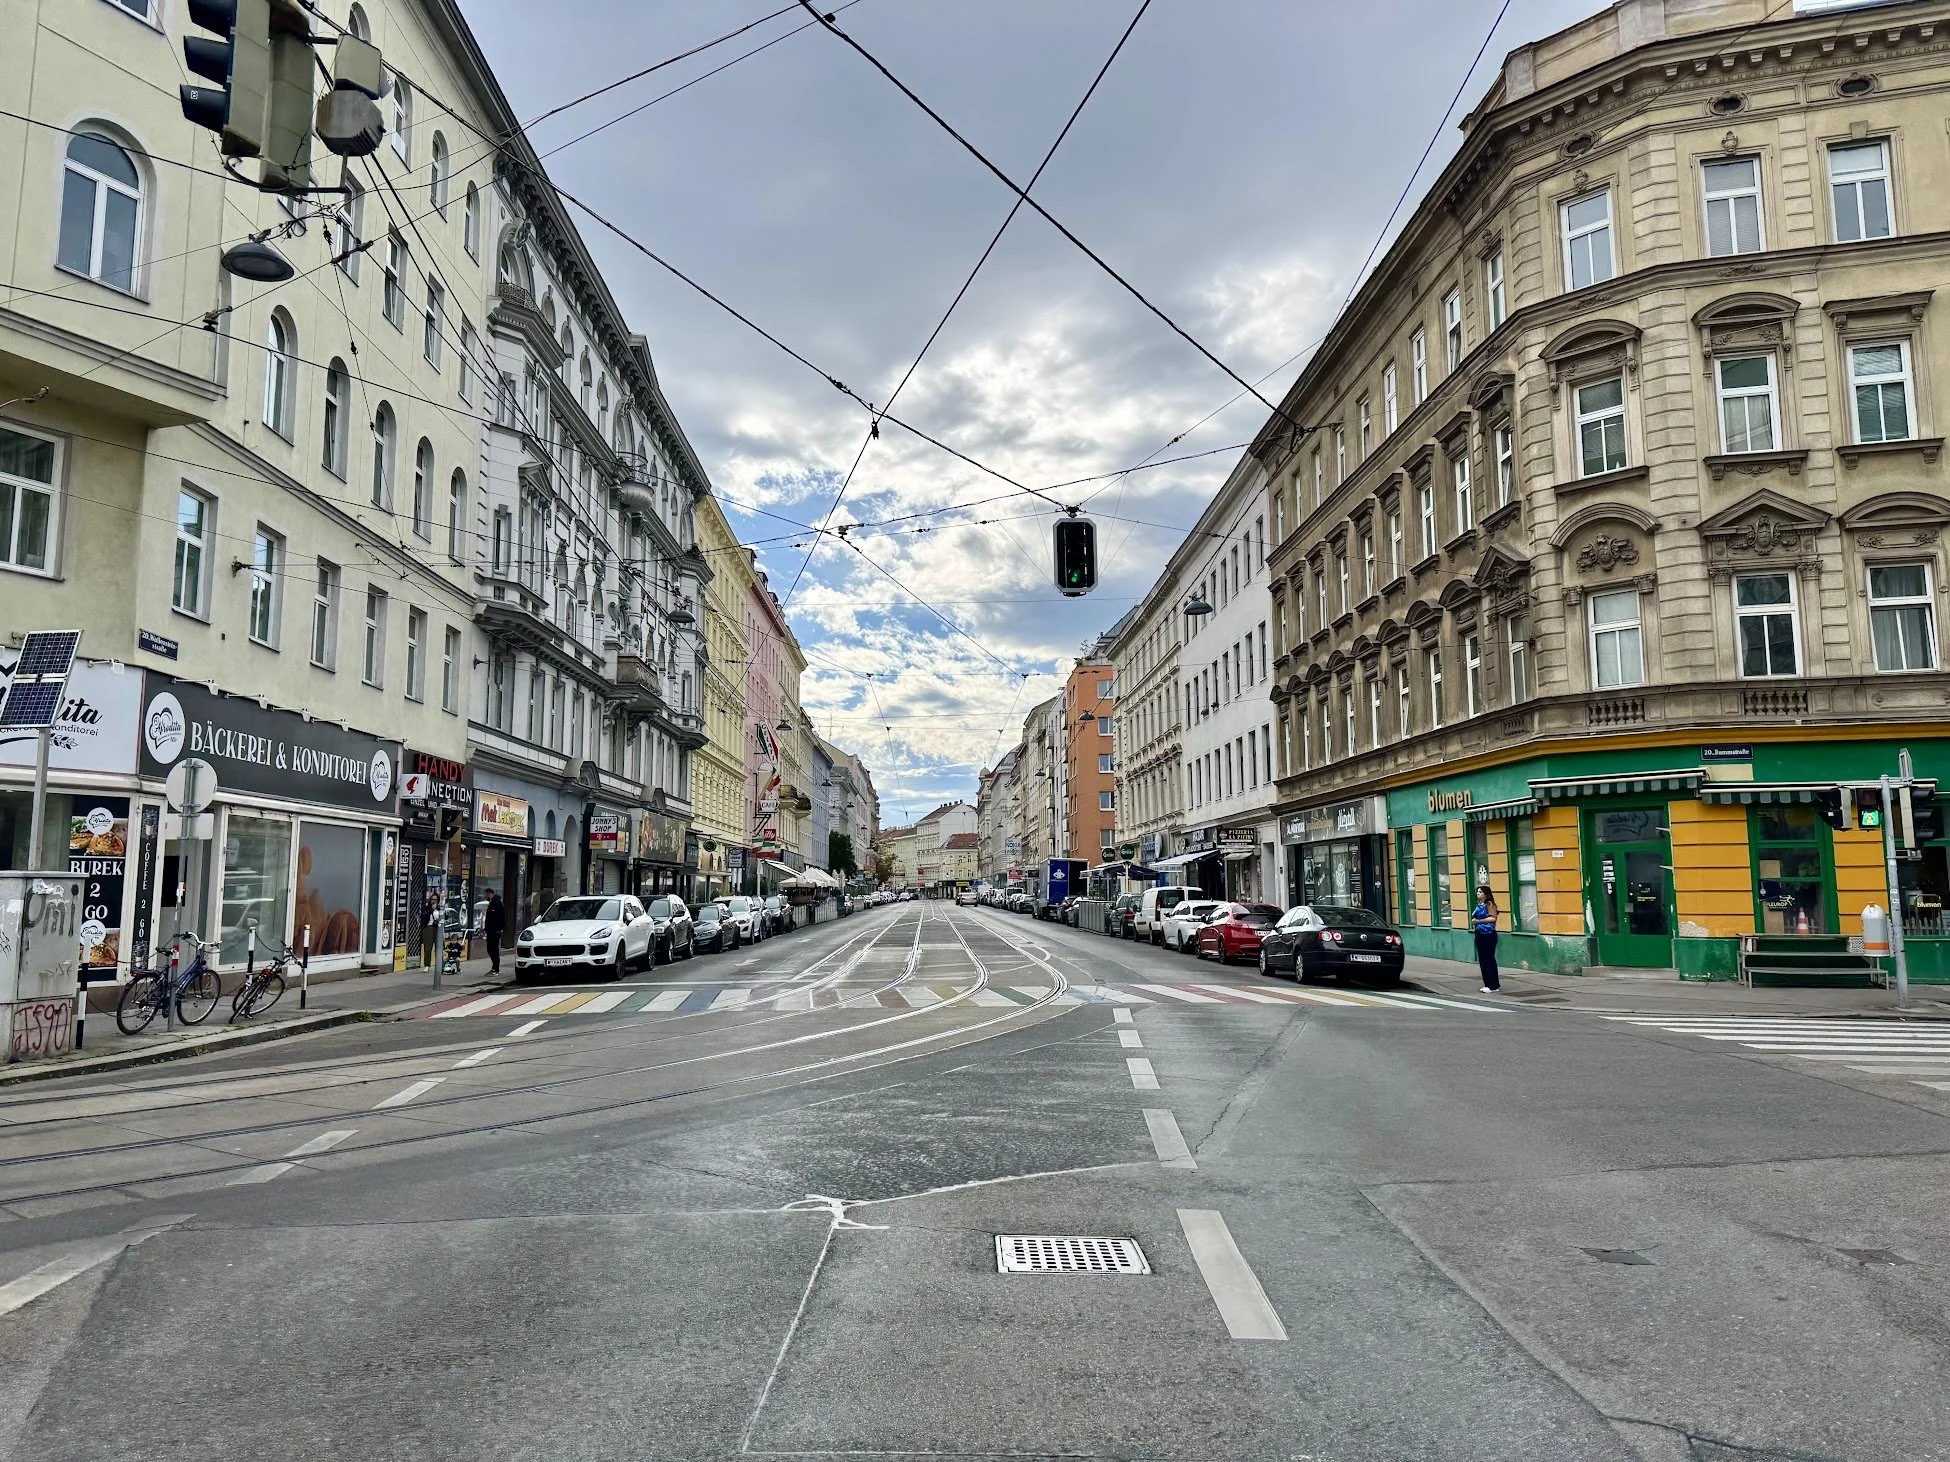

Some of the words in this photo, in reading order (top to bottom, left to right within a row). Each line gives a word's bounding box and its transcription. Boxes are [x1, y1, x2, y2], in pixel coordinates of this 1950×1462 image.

[190, 720, 273, 766] BÄCKEREI
[275, 742, 287, 770] &
[292, 745, 367, 785] KONDITOREI
[418, 754, 466, 783] HANDY
[1428, 789, 1472, 812] blumen
[764, 831, 776, 840] illy
[71, 861, 122, 876] BUREK
[90, 883, 101, 897] 2
[85, 905, 108, 919] GO
